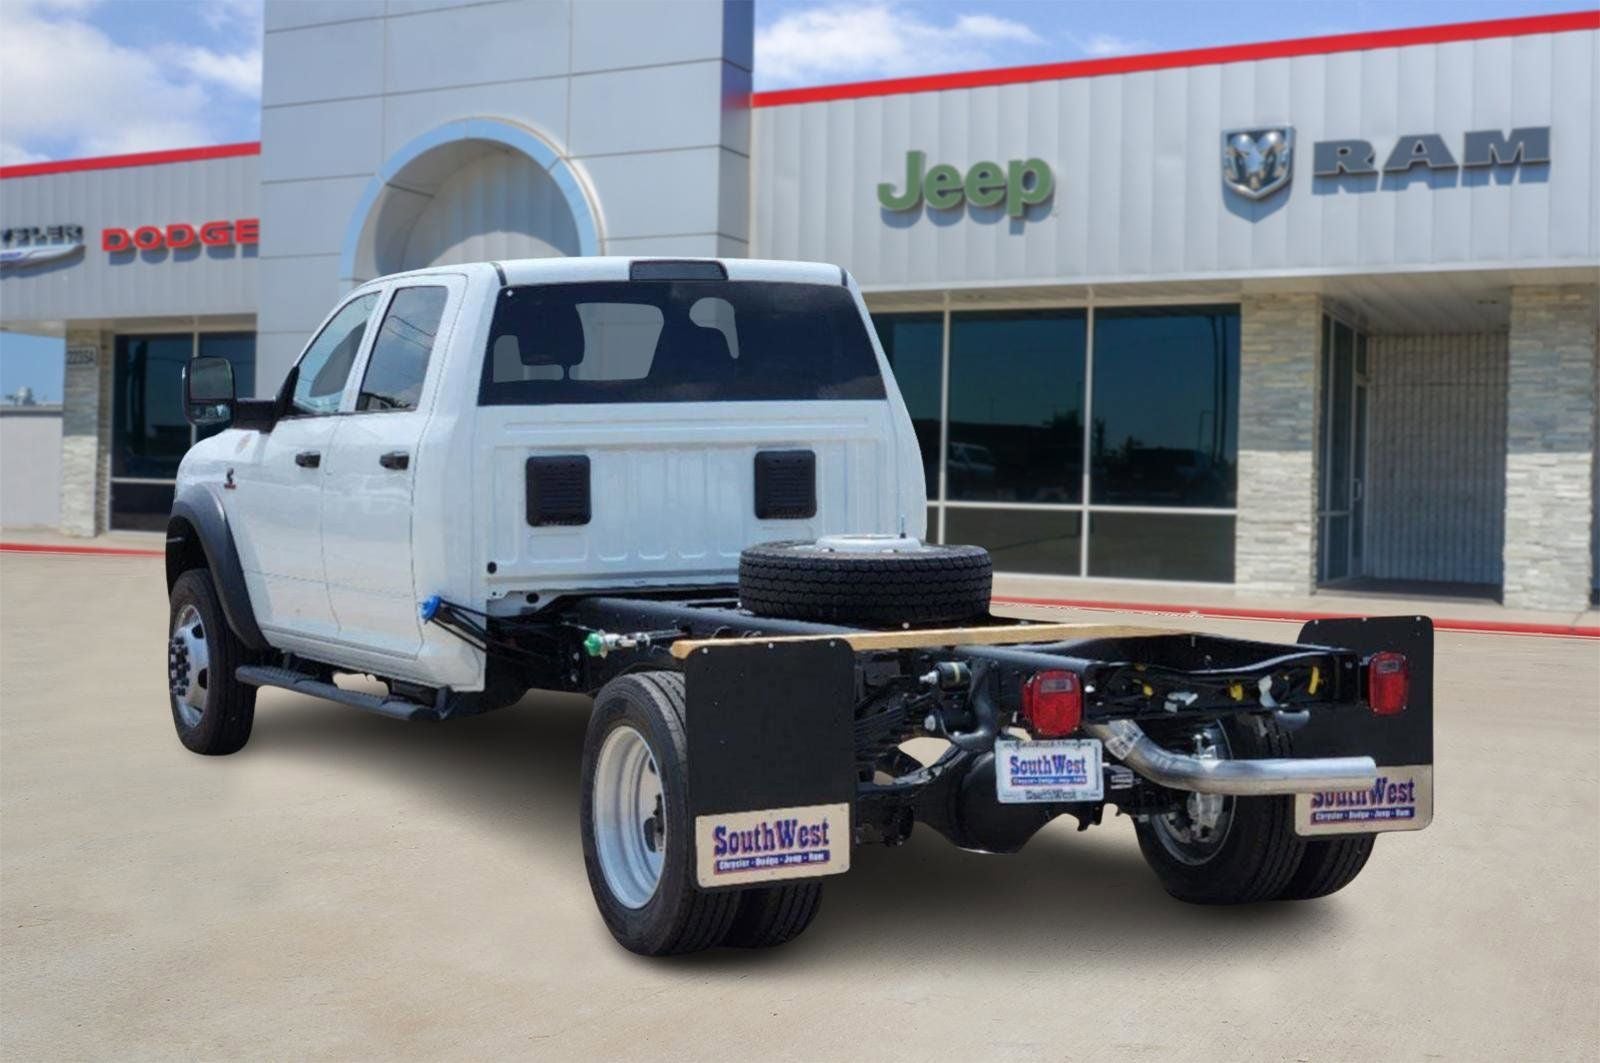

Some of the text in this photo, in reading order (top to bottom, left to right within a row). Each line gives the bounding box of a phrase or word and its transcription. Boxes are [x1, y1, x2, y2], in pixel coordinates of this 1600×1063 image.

[1313, 126, 1551, 176] RAM
[877, 150, 1054, 216] Jeep
[102, 218, 260, 252] DODGE
[1009, 754, 1087, 776] SouthWest
[713, 817, 830, 857] SouthWest
